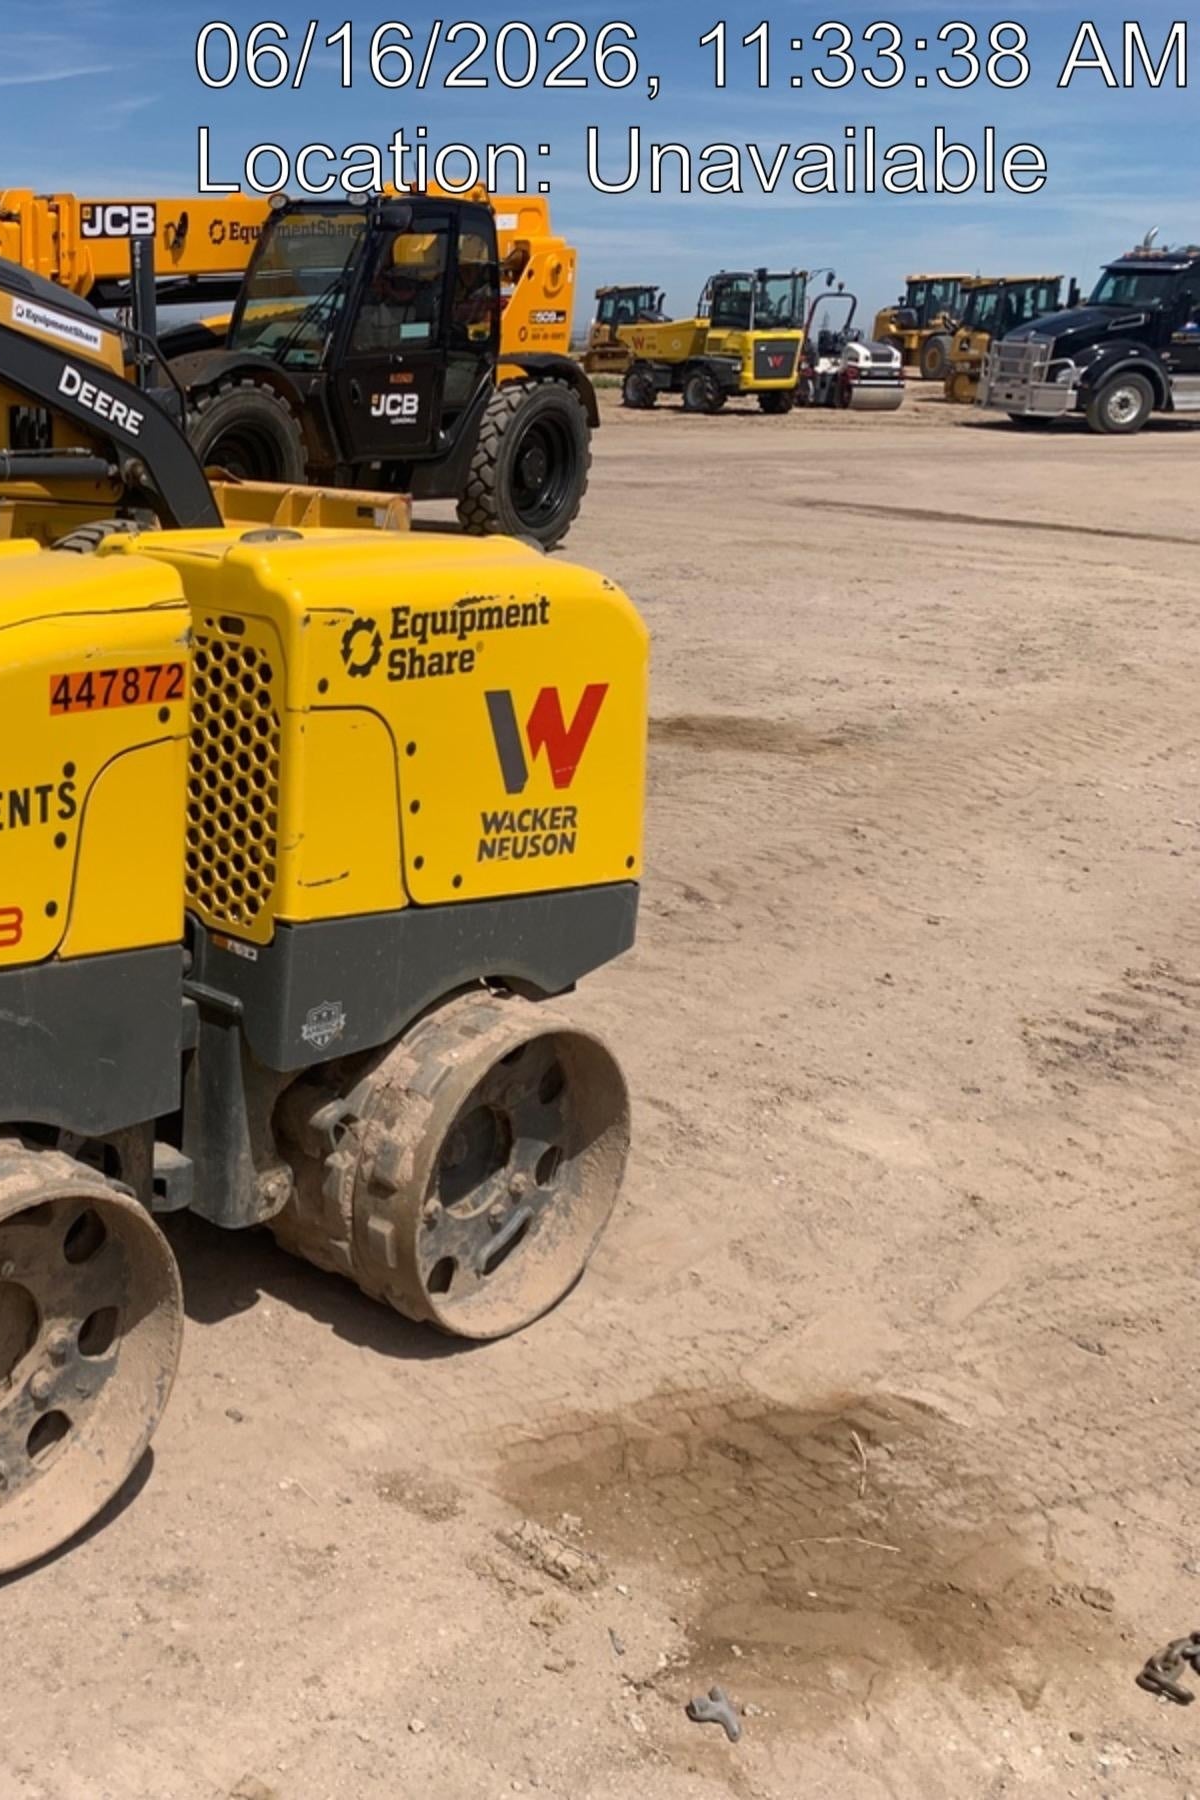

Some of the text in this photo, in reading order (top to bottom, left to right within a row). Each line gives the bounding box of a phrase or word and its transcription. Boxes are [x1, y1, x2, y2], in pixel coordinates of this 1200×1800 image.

[82, 206, 155, 236] JCB
[58, 364, 144, 436] DEERE
[371, 393, 419, 416] JCB
[389, 596, 550, 644] Equipment
[51, 663, 185, 712] 447872
[480, 805, 579, 836] WACKER
[476, 831, 577, 863] NEUSON
